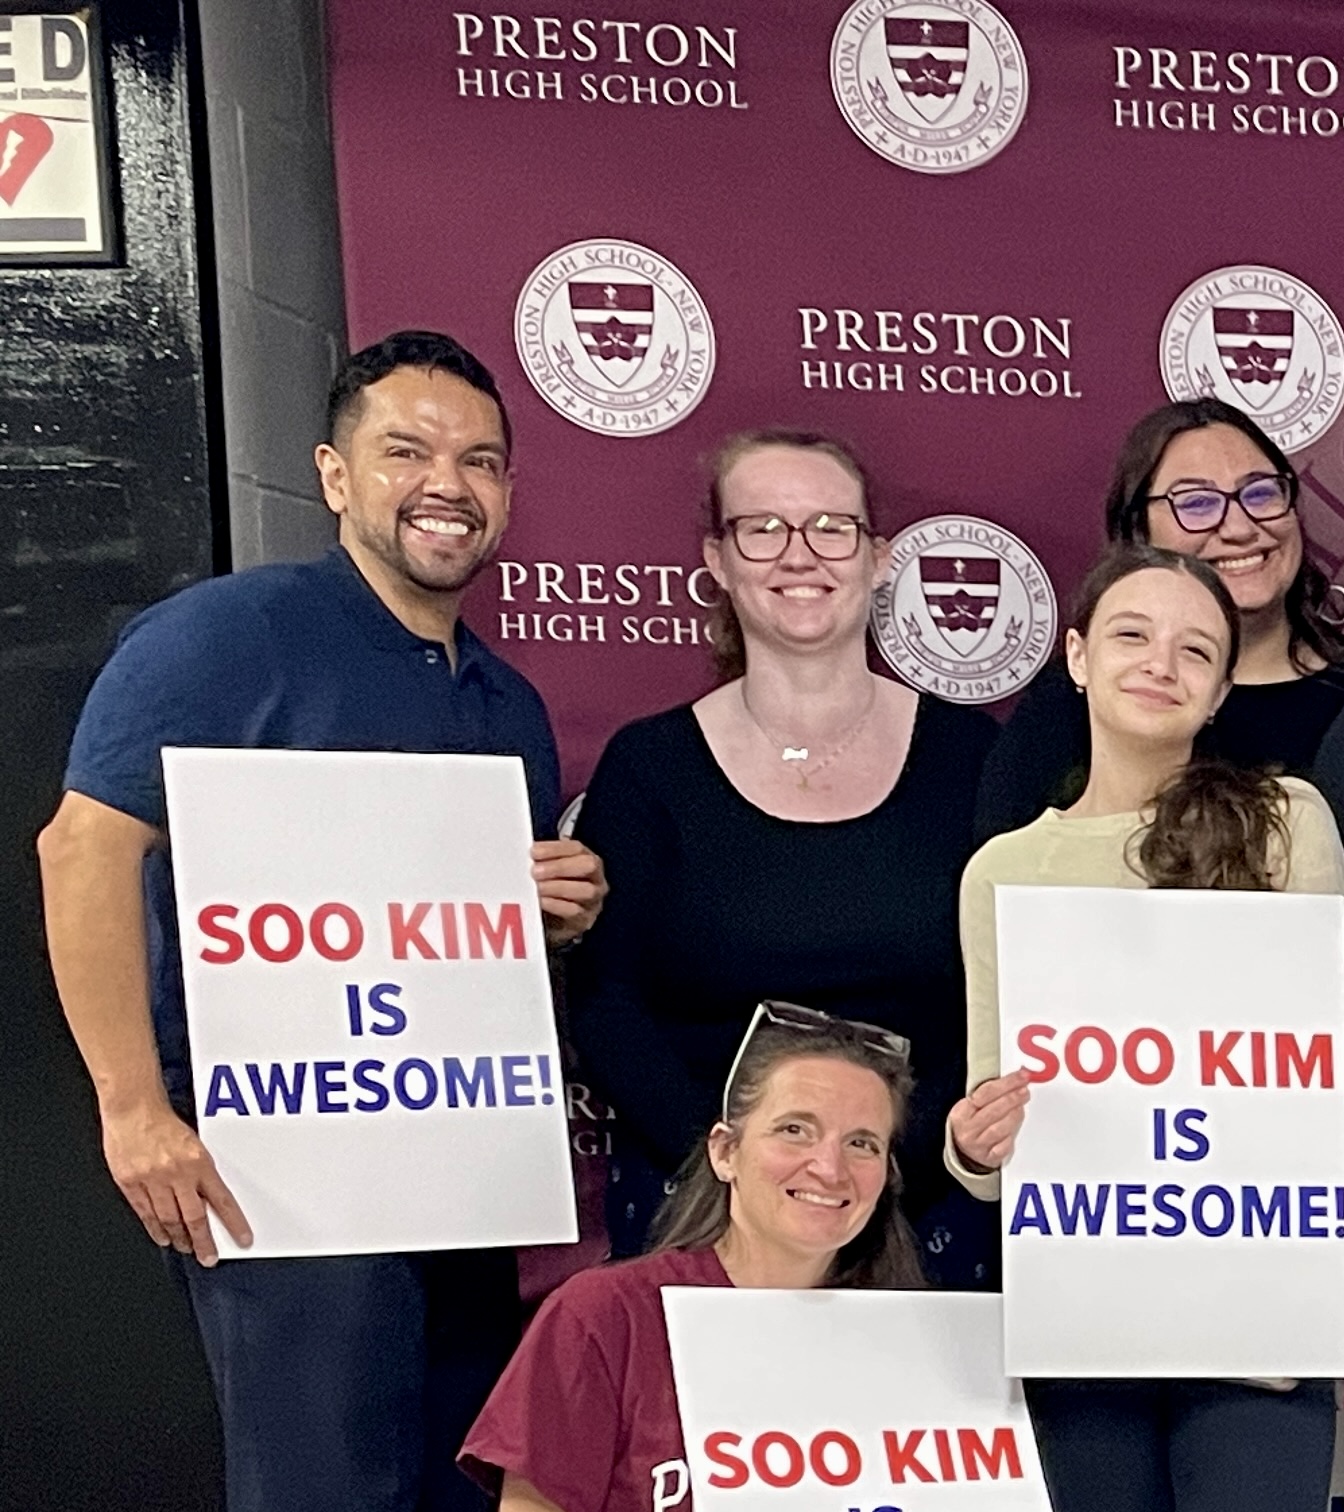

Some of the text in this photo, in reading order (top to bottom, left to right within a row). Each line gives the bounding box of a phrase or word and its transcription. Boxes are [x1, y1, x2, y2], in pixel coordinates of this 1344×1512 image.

[454, 14, 738, 69] PRESTON
[458, 68, 748, 109] HIGH SCHOOL
[1114, 99, 1216, 131] HIGH
[798, 308, 1073, 360] PRESTON
[802, 360, 1082, 398] HIGH SCHOOL
[498, 561, 719, 608] PRESTO
[499, 613, 606, 643] HIGH
[197, 903, 526, 965] SOO KIM
[346, 983, 407, 1037] IS
[1017, 1024, 1334, 1089] SOO KIM
[204, 1055, 555, 1118] AWESOME!
[1153, 1108, 1210, 1162] IS
[704, 1427, 1024, 1489] SOO KIM
